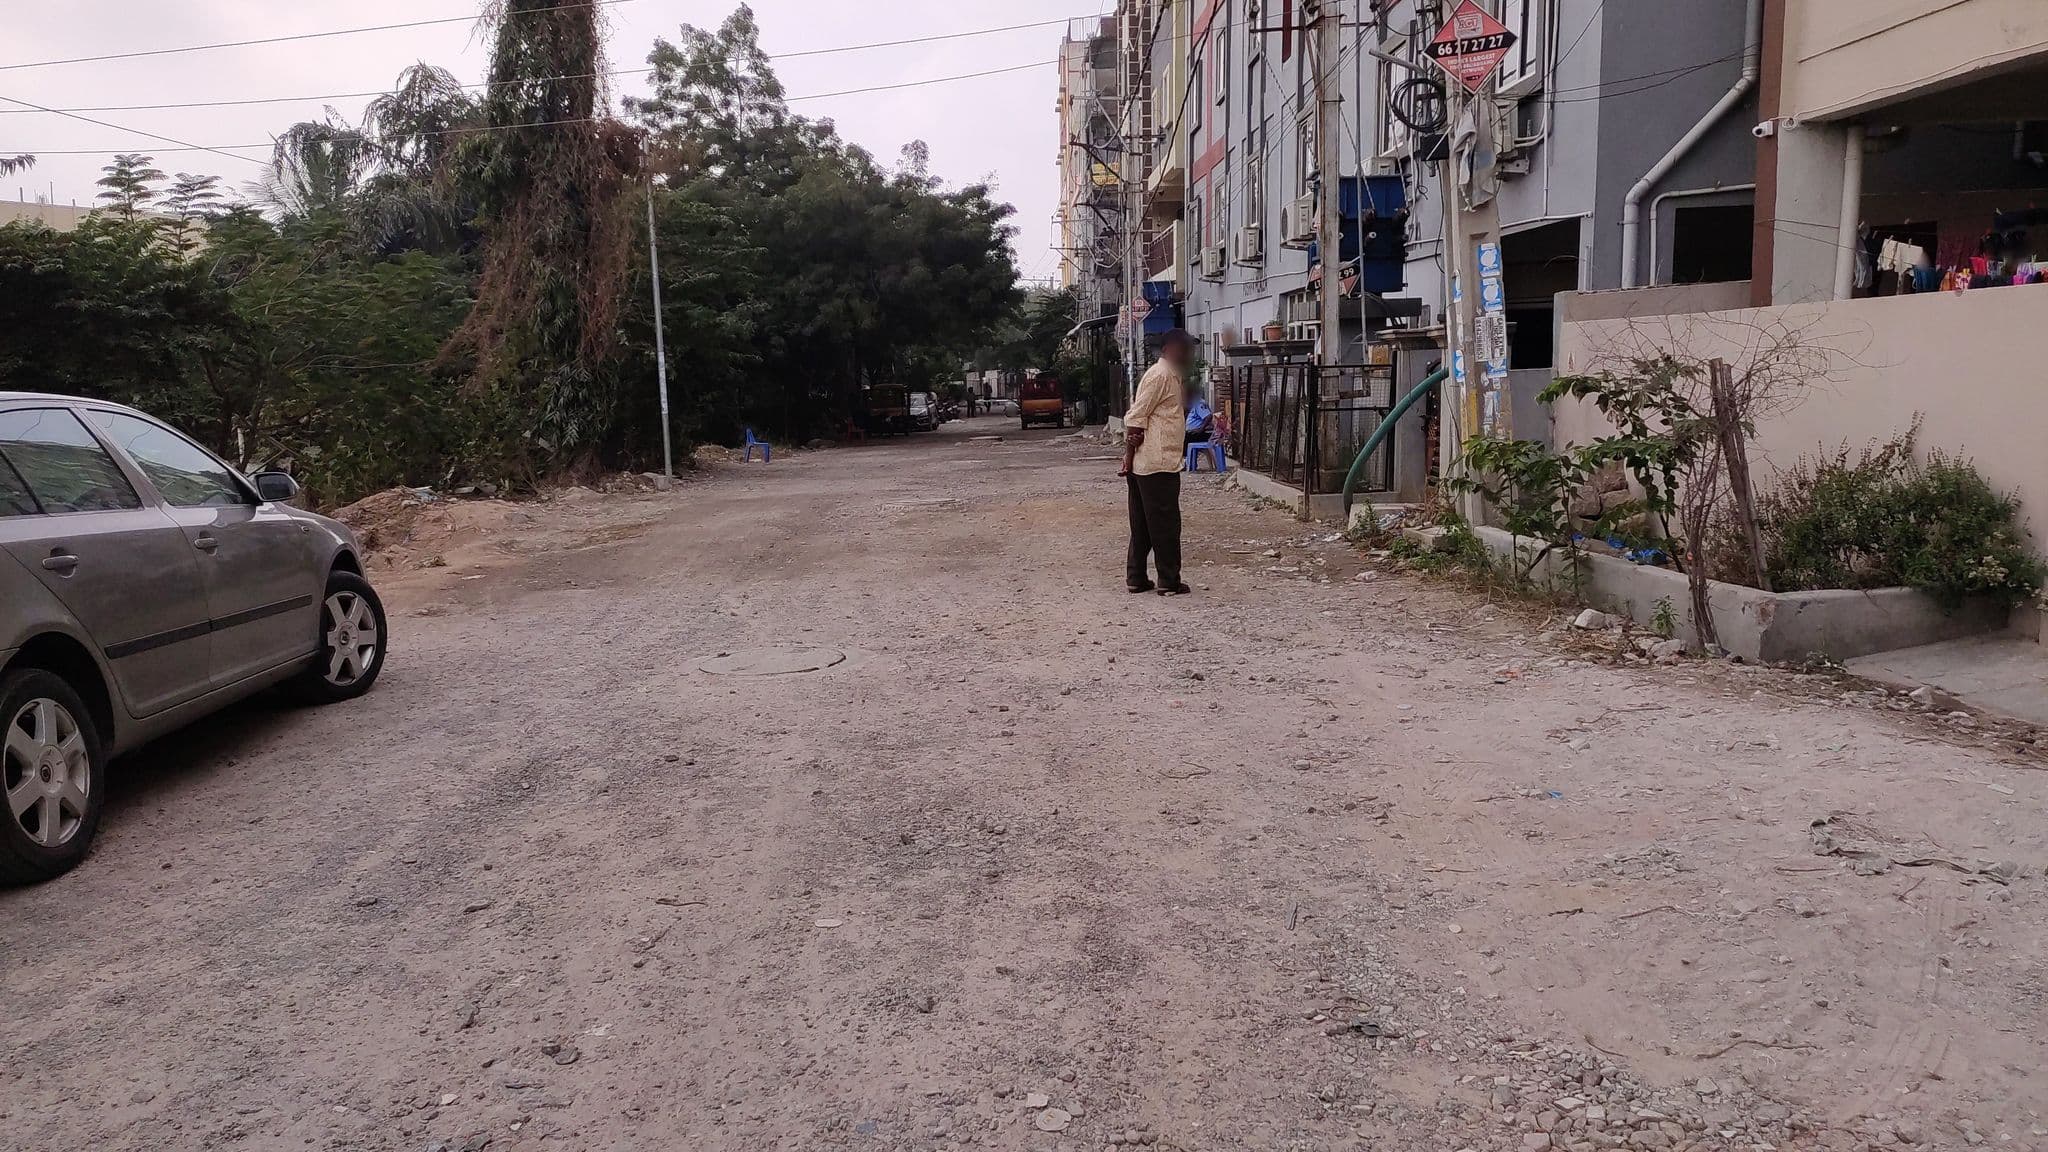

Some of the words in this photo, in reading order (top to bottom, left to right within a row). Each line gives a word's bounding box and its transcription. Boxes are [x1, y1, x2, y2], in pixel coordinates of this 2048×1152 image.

[1437, 42, 1453, 55] 66
[1471, 38, 1486, 51] 27
[1488, 35, 1504, 48] 27
[1469, 53, 1495, 62] LARGEST
